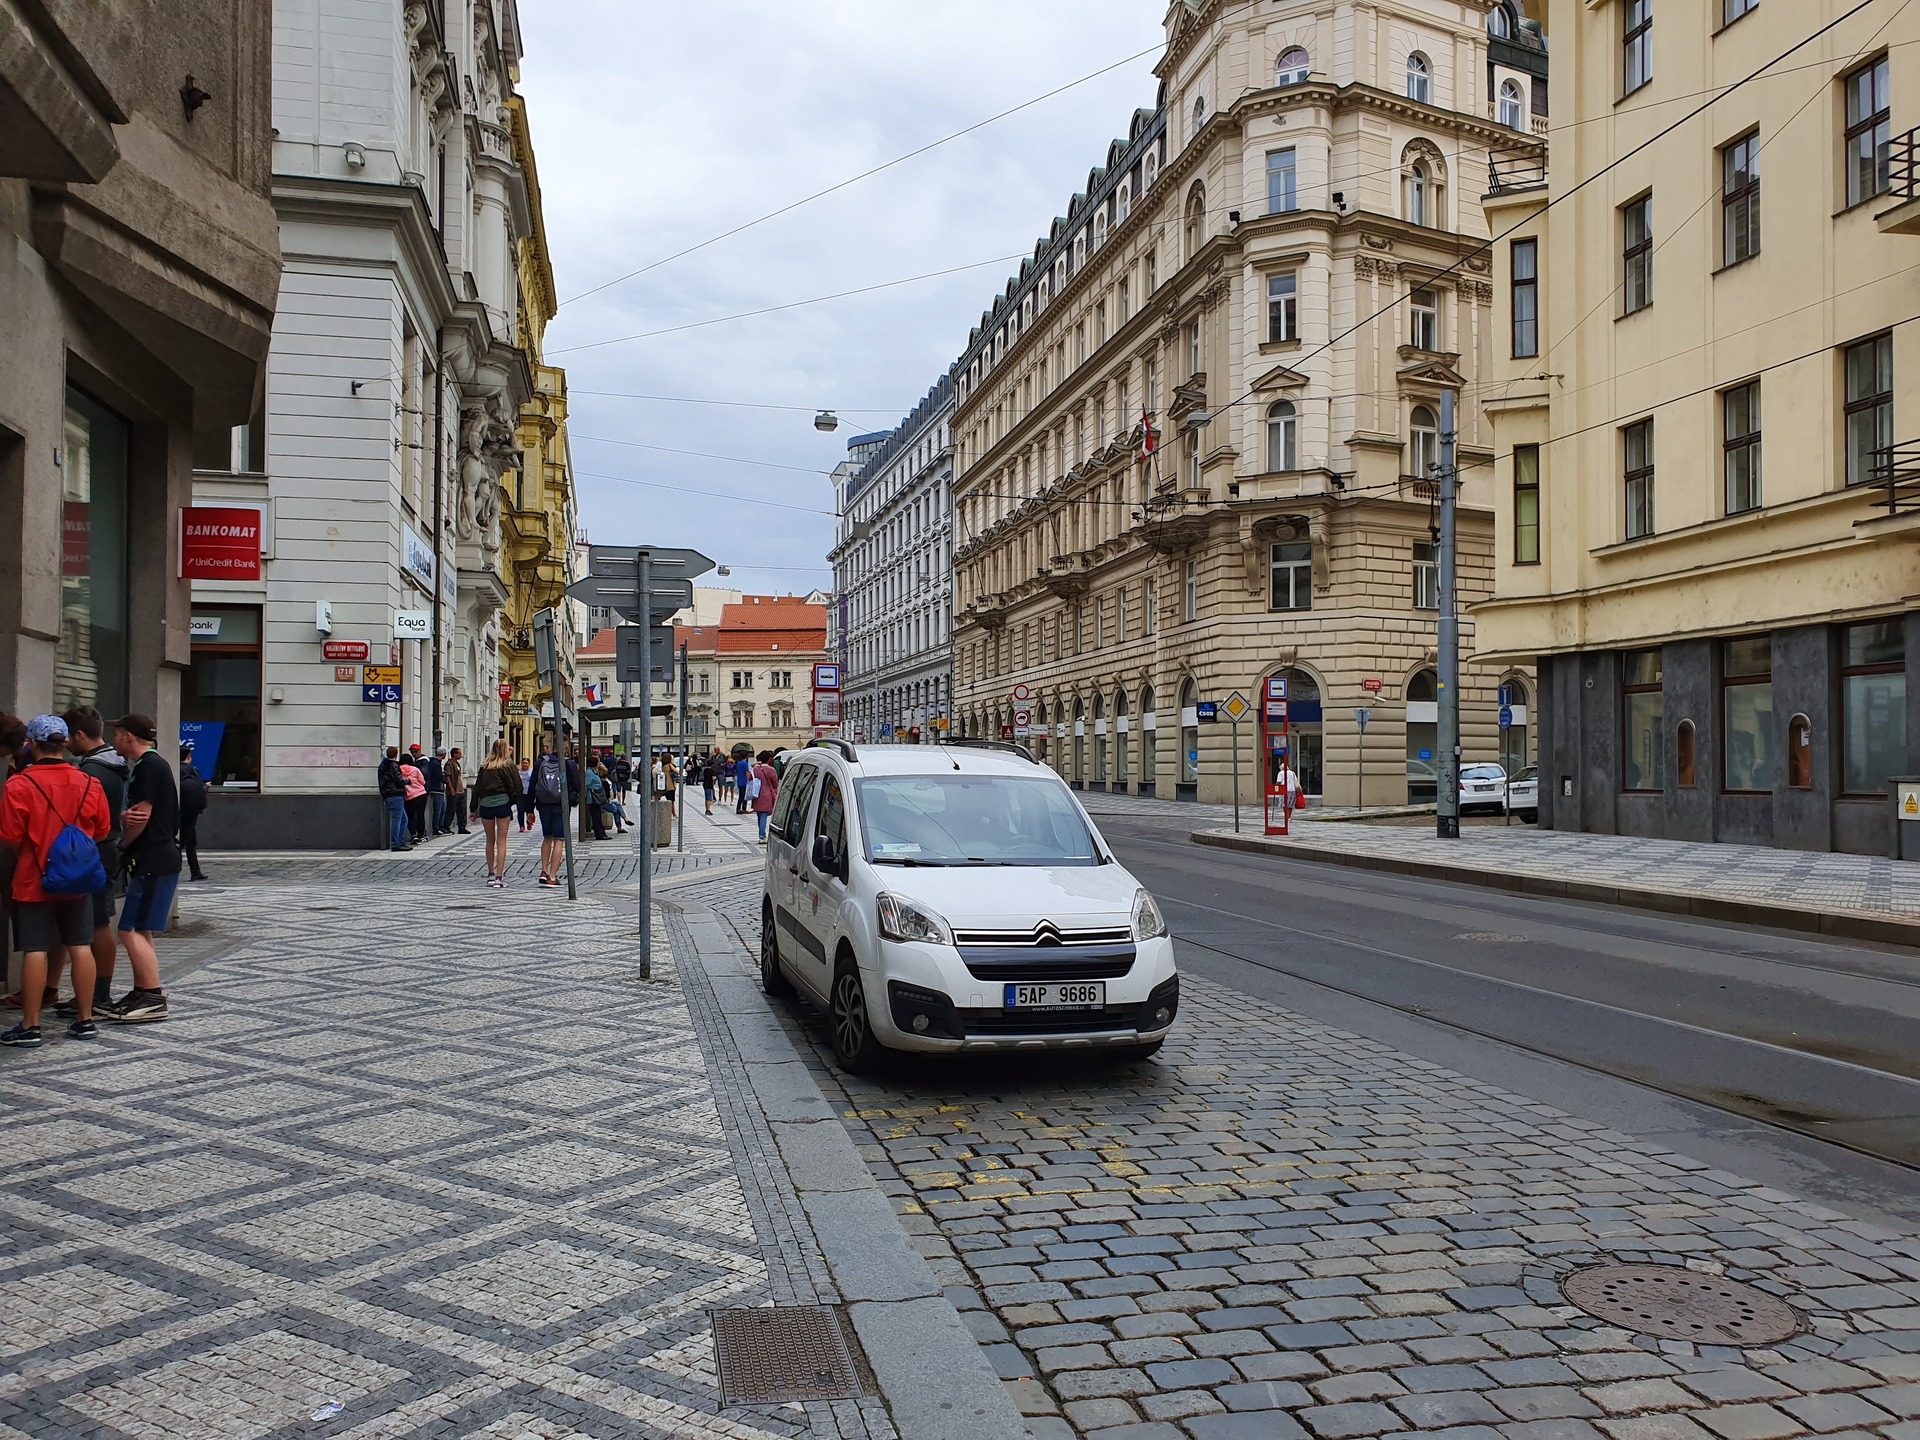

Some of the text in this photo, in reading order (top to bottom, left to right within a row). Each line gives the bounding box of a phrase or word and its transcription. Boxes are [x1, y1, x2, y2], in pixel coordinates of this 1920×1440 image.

[186, 525, 257, 538] BANKOMAT
[195, 557, 256, 569] UniCredit Bank
[398, 616, 426, 629] Equa
[182, 723, 203, 732] účet
[1019, 985, 1097, 1004] 5AP 9686
